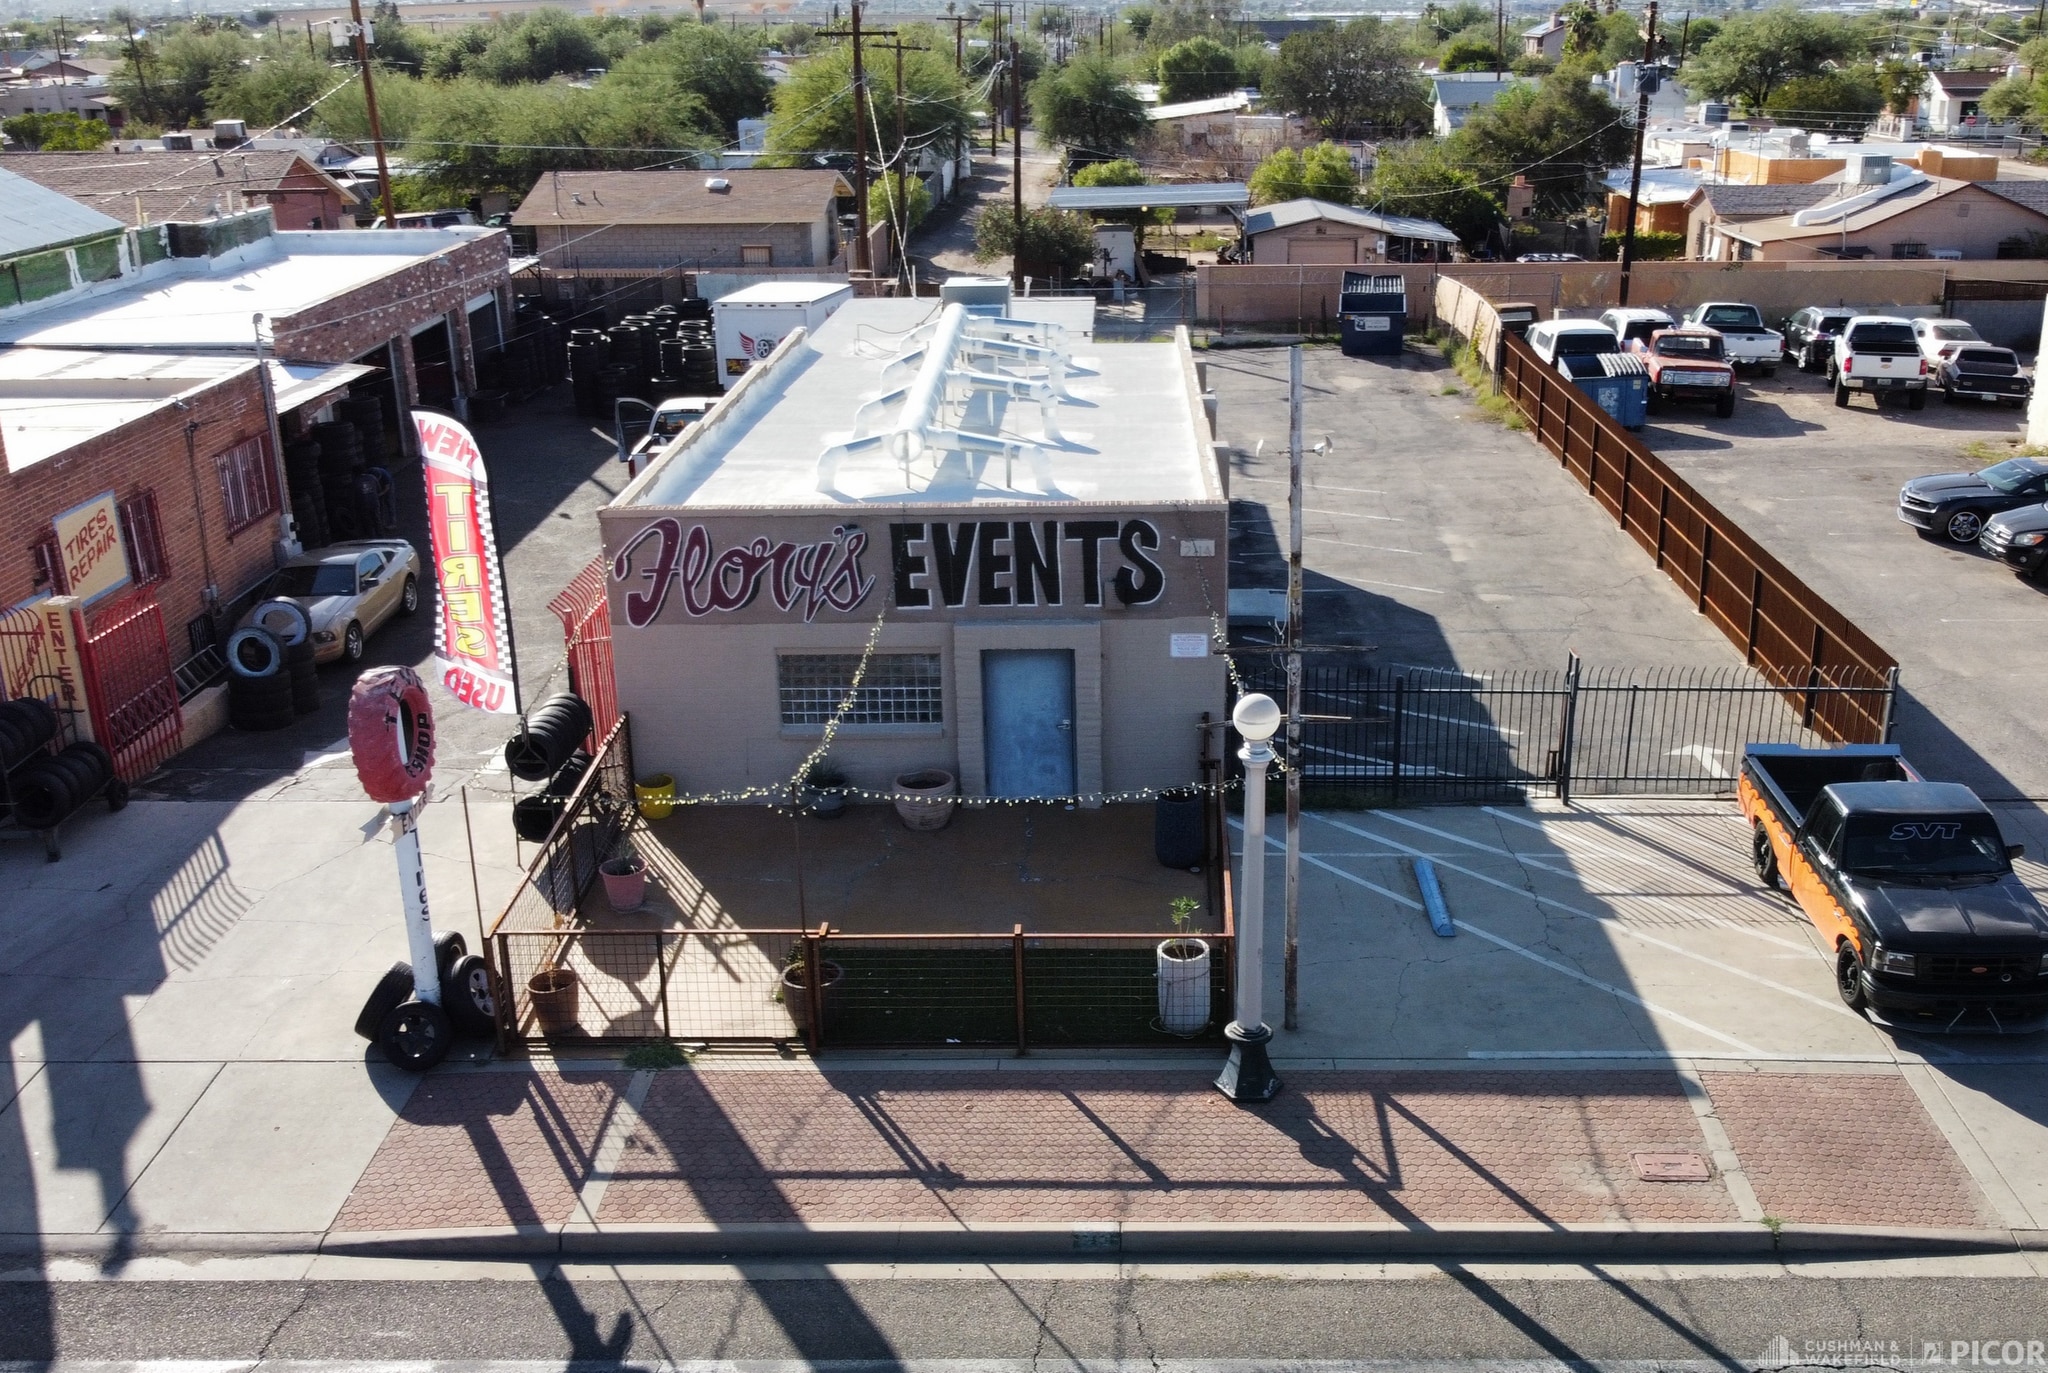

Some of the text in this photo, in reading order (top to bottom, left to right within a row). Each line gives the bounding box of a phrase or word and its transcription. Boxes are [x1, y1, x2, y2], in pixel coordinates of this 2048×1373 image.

[64, 507, 109, 561] TIRES
[68, 524, 118, 591] REPAIR
[613, 516, 1166, 628] Flory's EVENTS
[46, 611, 78, 702] ENTER
[1889, 822, 1962, 841] SVT
